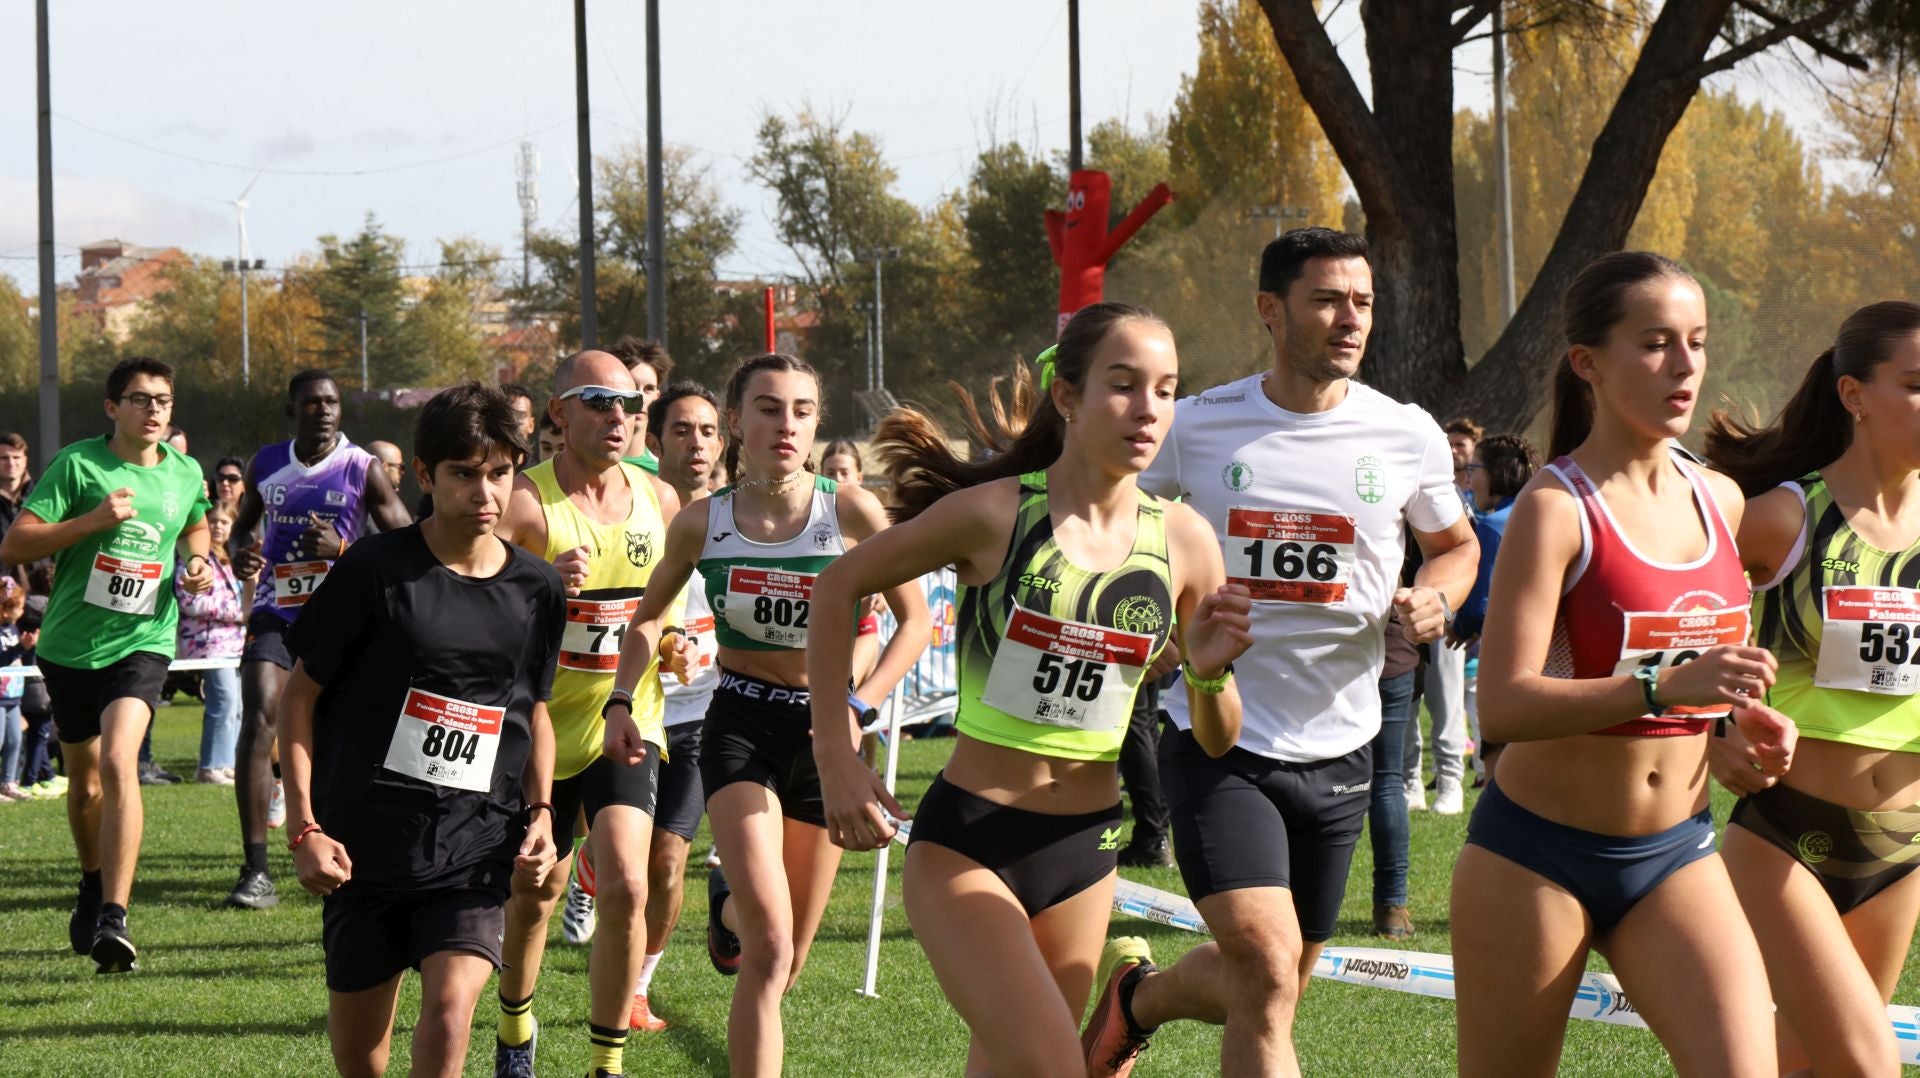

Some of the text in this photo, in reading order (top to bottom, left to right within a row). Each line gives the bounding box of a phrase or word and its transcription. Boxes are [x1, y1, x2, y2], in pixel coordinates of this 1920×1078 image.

[1203, 393, 1246, 405] hummel
[265, 484, 288, 506] 16
[1273, 513, 1312, 523] CROSS
[1267, 529, 1317, 540] Palencia
[1275, 523, 1303, 531] Municipal
[112, 536, 159, 553] ARTIZA
[1243, 540, 1338, 581] 166
[1821, 559, 1859, 573] 42K
[108, 575, 145, 599] 807
[288, 575, 316, 595] 97
[766, 573, 801, 584] CROSS
[1018, 574, 1062, 593] 42K
[760, 586, 804, 599] Palencia
[1873, 592, 1912, 602] CROS
[598, 602, 626, 611] CROSS
[753, 596, 810, 629] 802
[594, 615, 628, 623] Palencia
[1679, 615, 1718, 628] CROSS
[586, 623, 626, 653] 71
[1021, 624, 1058, 640] Patronato
[1058, 633, 1094, 647] Municipal
[1095, 639, 1104, 648] de
[1060, 624, 1105, 642] CROSS
[1669, 635, 1718, 648] Palencia
[1048, 641, 1105, 661] Palencia
[1032, 652, 1108, 702] 515
[445, 702, 479, 717] CROSS
[436, 714, 478, 732] Palencia
[422, 725, 480, 765] 804
